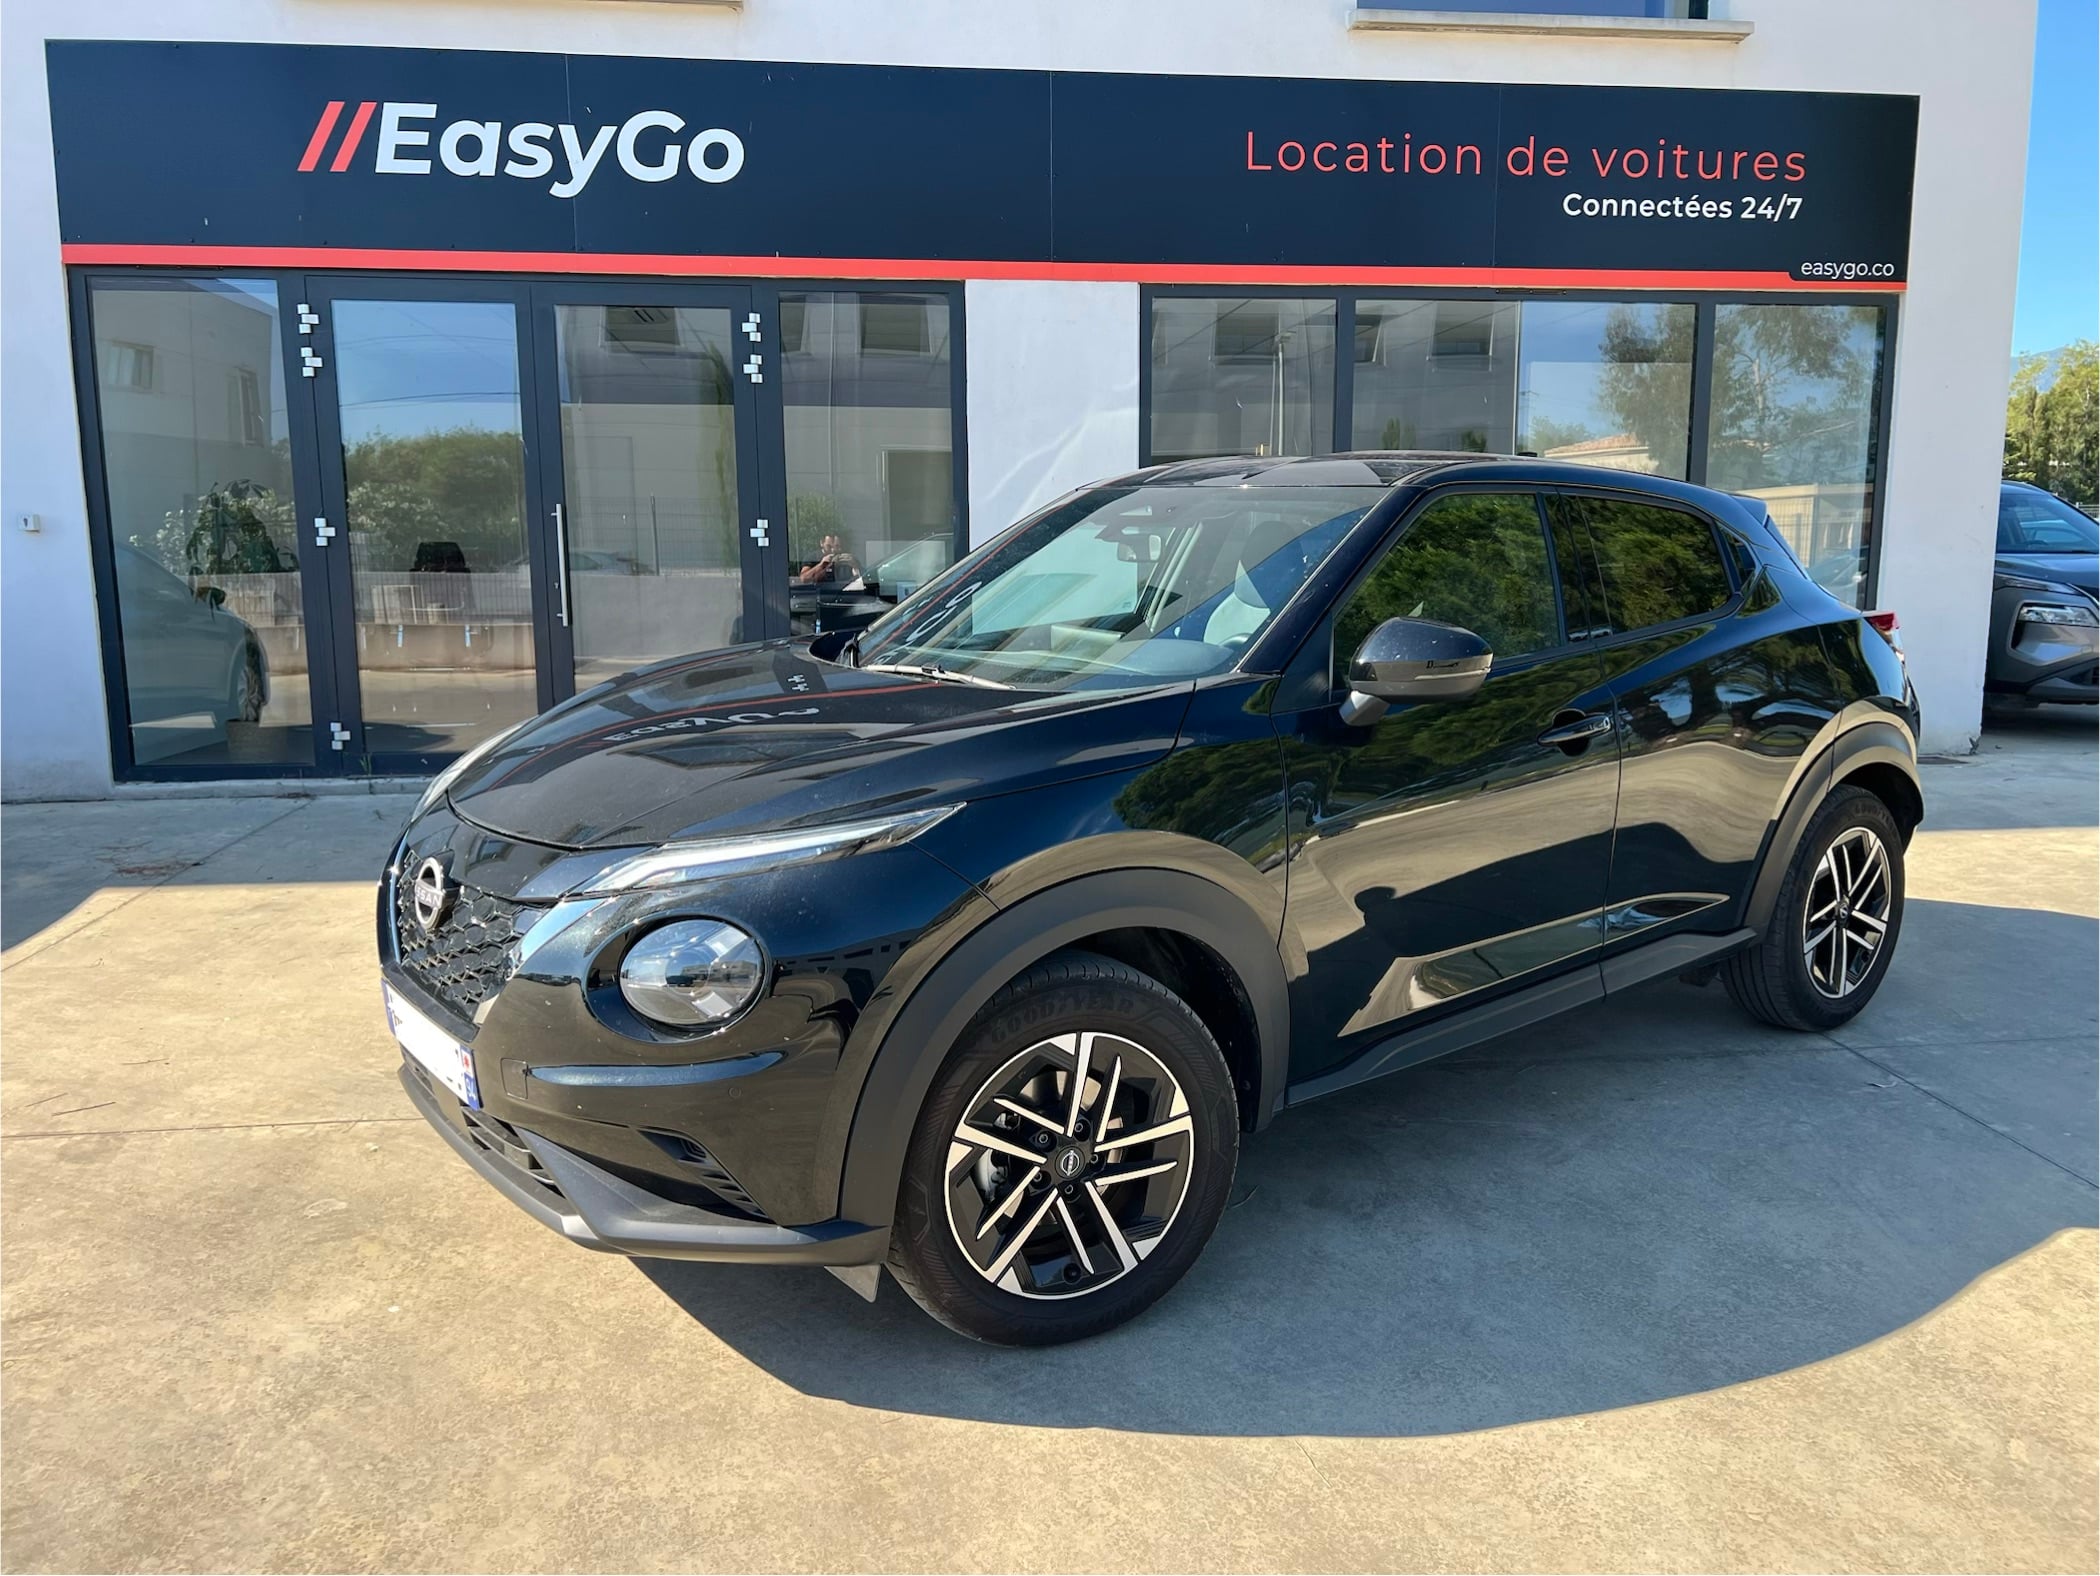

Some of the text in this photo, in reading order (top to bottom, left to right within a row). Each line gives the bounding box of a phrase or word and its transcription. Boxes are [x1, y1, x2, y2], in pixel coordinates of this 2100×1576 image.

[1246, 131, 1805, 181] Location de voitures
[1562, 193, 1803, 221] Connectées 24/7
[1800, 261, 1895, 280] easygo.co
